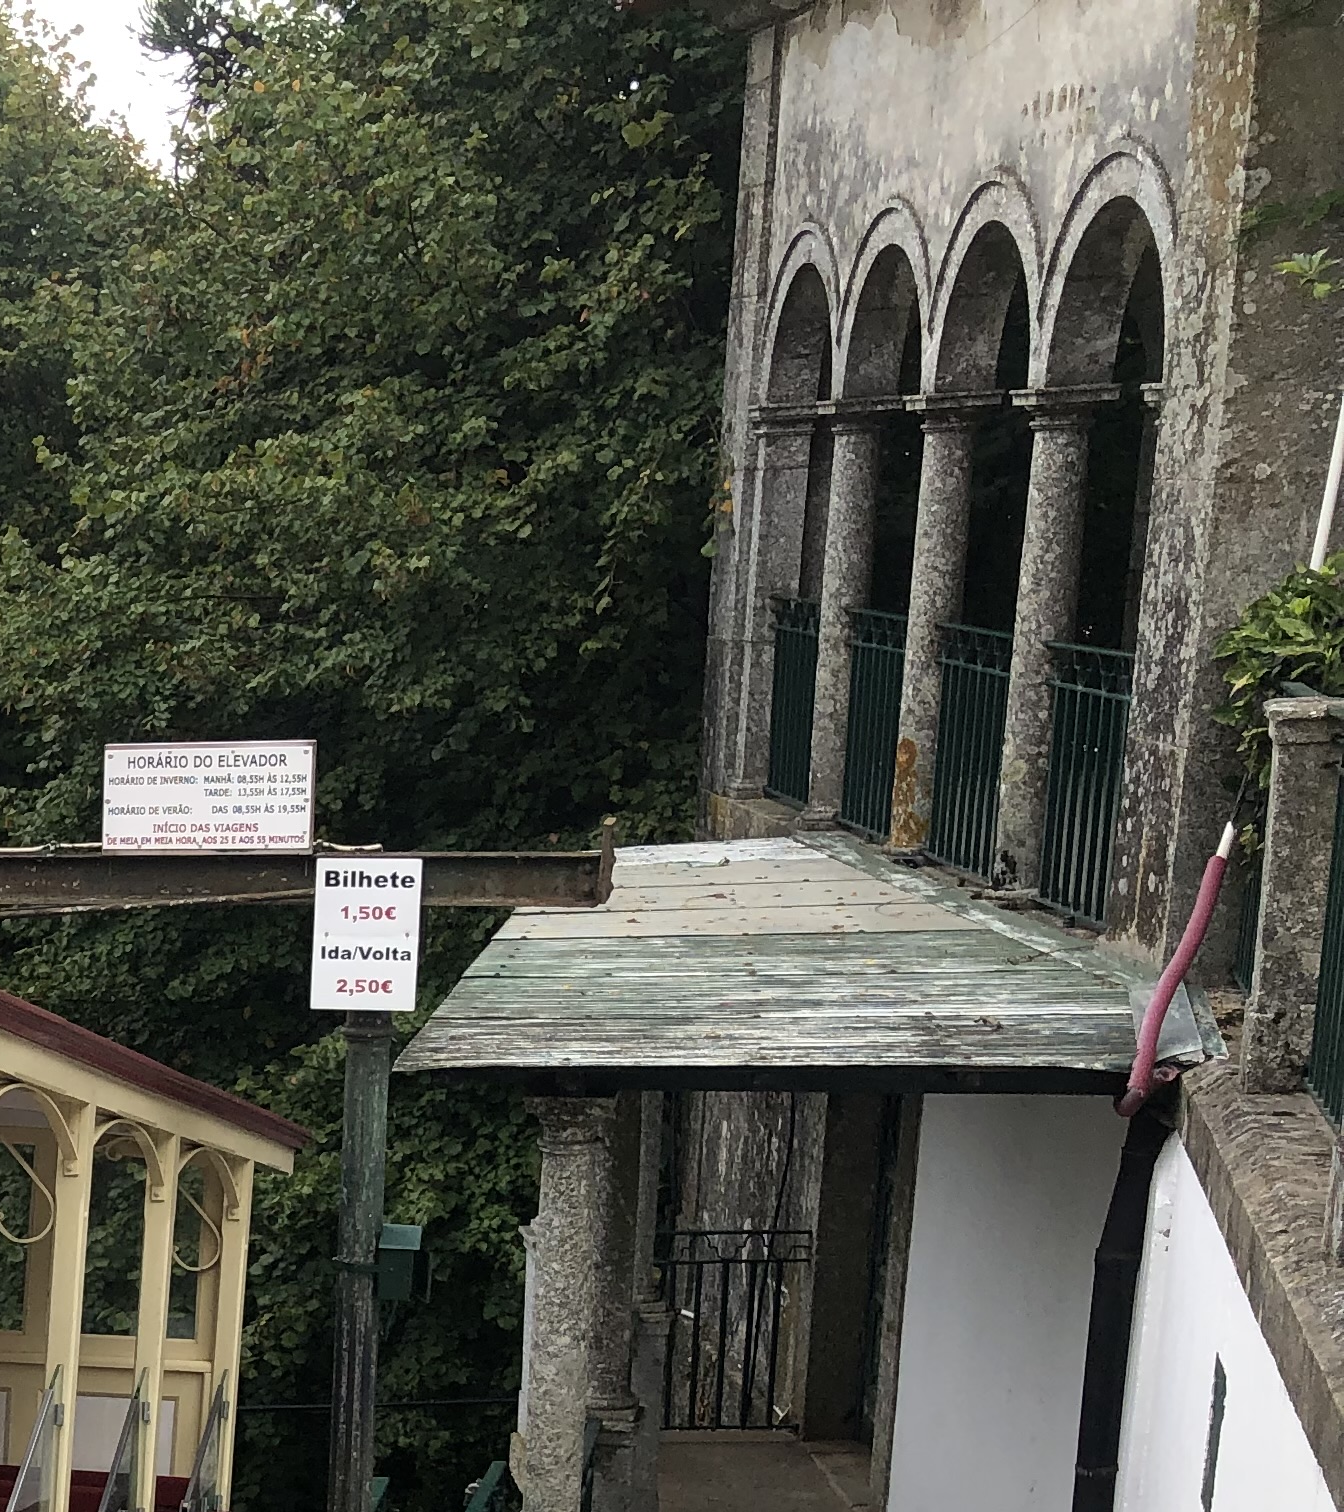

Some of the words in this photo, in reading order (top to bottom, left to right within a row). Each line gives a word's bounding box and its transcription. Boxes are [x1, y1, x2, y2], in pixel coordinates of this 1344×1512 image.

[127, 751, 189, 769] HORÁRIO
[193, 755, 213, 768] DO
[218, 754, 288, 768] ELEVADOR
[108, 774, 145, 786] HORÁRIO
[147, 776, 158, 785] DE
[160, 775, 198, 785] INVERNO:
[203, 772, 235, 785] MANHÃ:
[237, 774, 265, 786] 08,55H
[280, 773, 308, 785] 12,55H
[203, 787, 233, 798] TARDE:
[237, 787, 265, 798] 13,55H
[280, 786, 307, 798] 17,55H
[107, 804, 146, 816] HORÁRIO
[148, 806, 160, 815] DE
[162, 804, 193, 815] VERÃO:
[211, 805, 229, 815] DAS
[232, 804, 262, 816] 08,55H
[277, 803, 307, 815] 19,55H
[152, 821, 187, 834] INÍCIO
[190, 823, 211, 833] DAS
[214, 822, 259, 833] VIAGENS
[106, 836, 118, 846] DE
[119, 836, 140, 846] MEIA
[140, 836, 152, 846] EM
[154, 836, 173, 846] MEIA
[238, 835, 255, 845] AOS
[268, 834, 306, 844] MINUTOS
[324, 869, 416, 889] Bilhete
[340, 905, 397, 924] 1,50€
[320, 945, 412, 961] Ida/Volta
[335, 979, 394, 997] 2,50€
